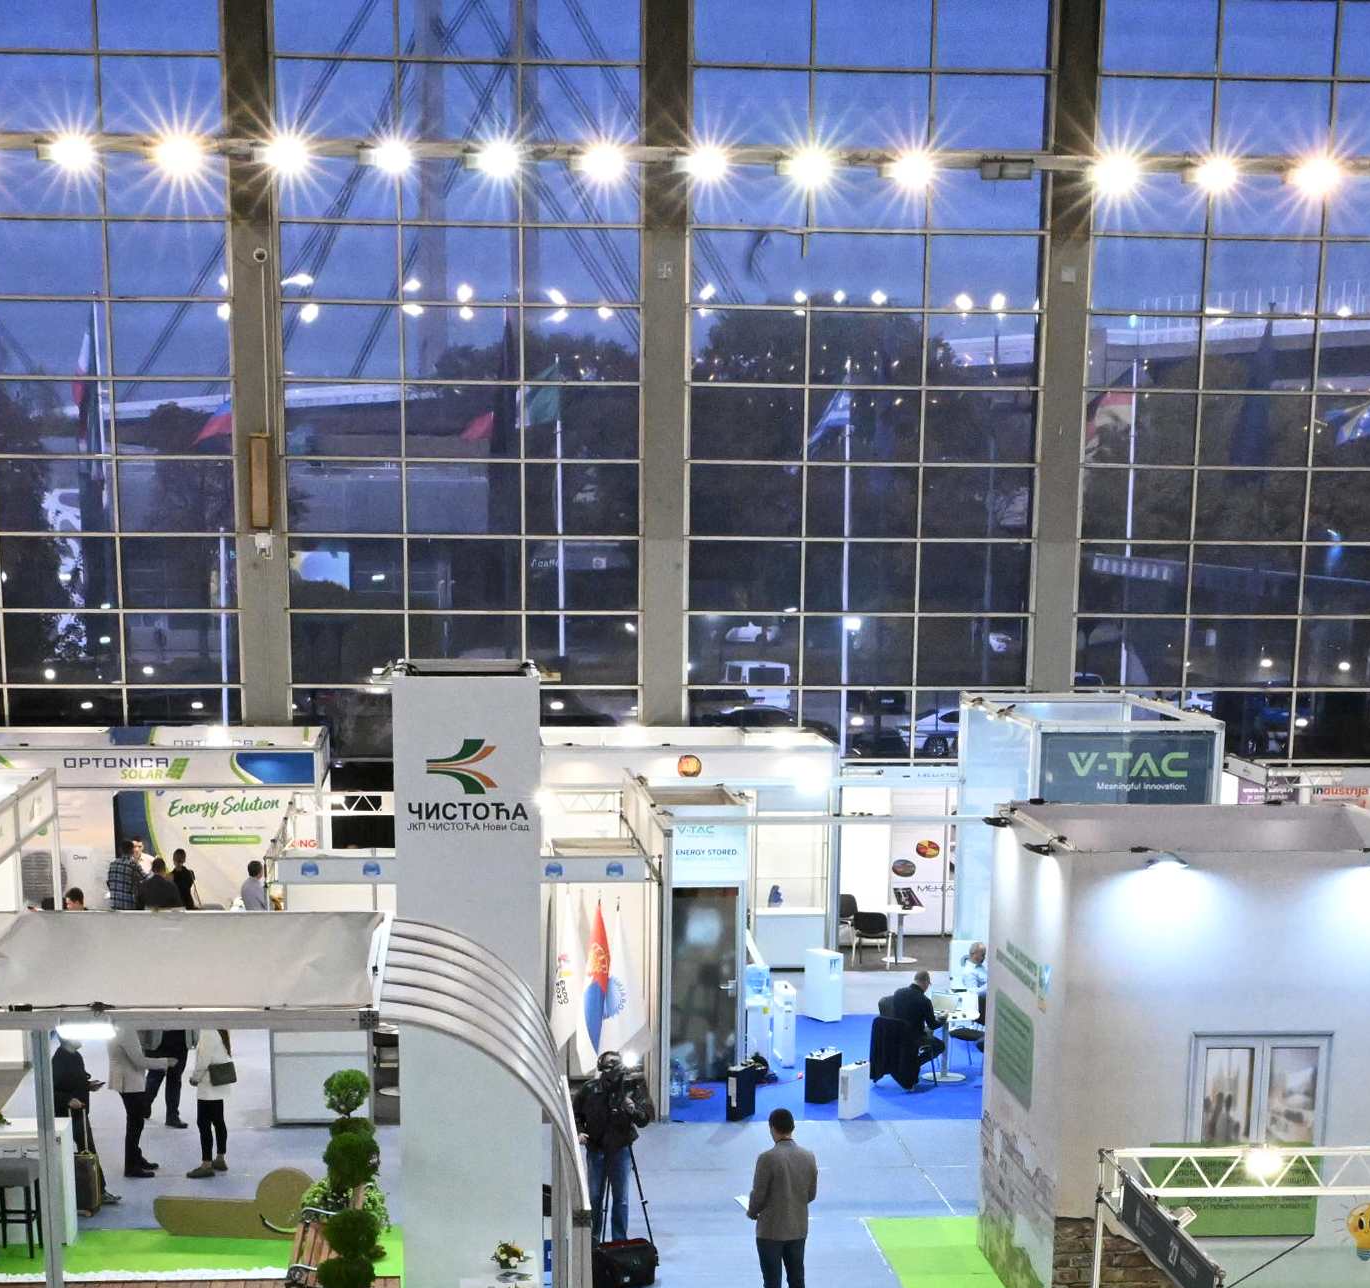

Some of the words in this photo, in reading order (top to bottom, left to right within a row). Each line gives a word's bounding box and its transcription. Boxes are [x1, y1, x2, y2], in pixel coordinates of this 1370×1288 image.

[63, 757, 169, 768] OPTONICA
[1067, 752, 1189, 778] V-TAC
[120, 769, 166, 780] SOLAR
[1096, 782, 1141, 792] Meaningful
[167, 799, 219, 818] Energy
[221, 796, 279, 815] Solution
[408, 802, 528, 820] ЧИСТОЋА
[428, 823, 480, 832] ЧИСТОЋА
[482, 823, 507, 832] Нови
[510, 823, 529, 833] Сад
[677, 825, 715, 834] V-TAC
